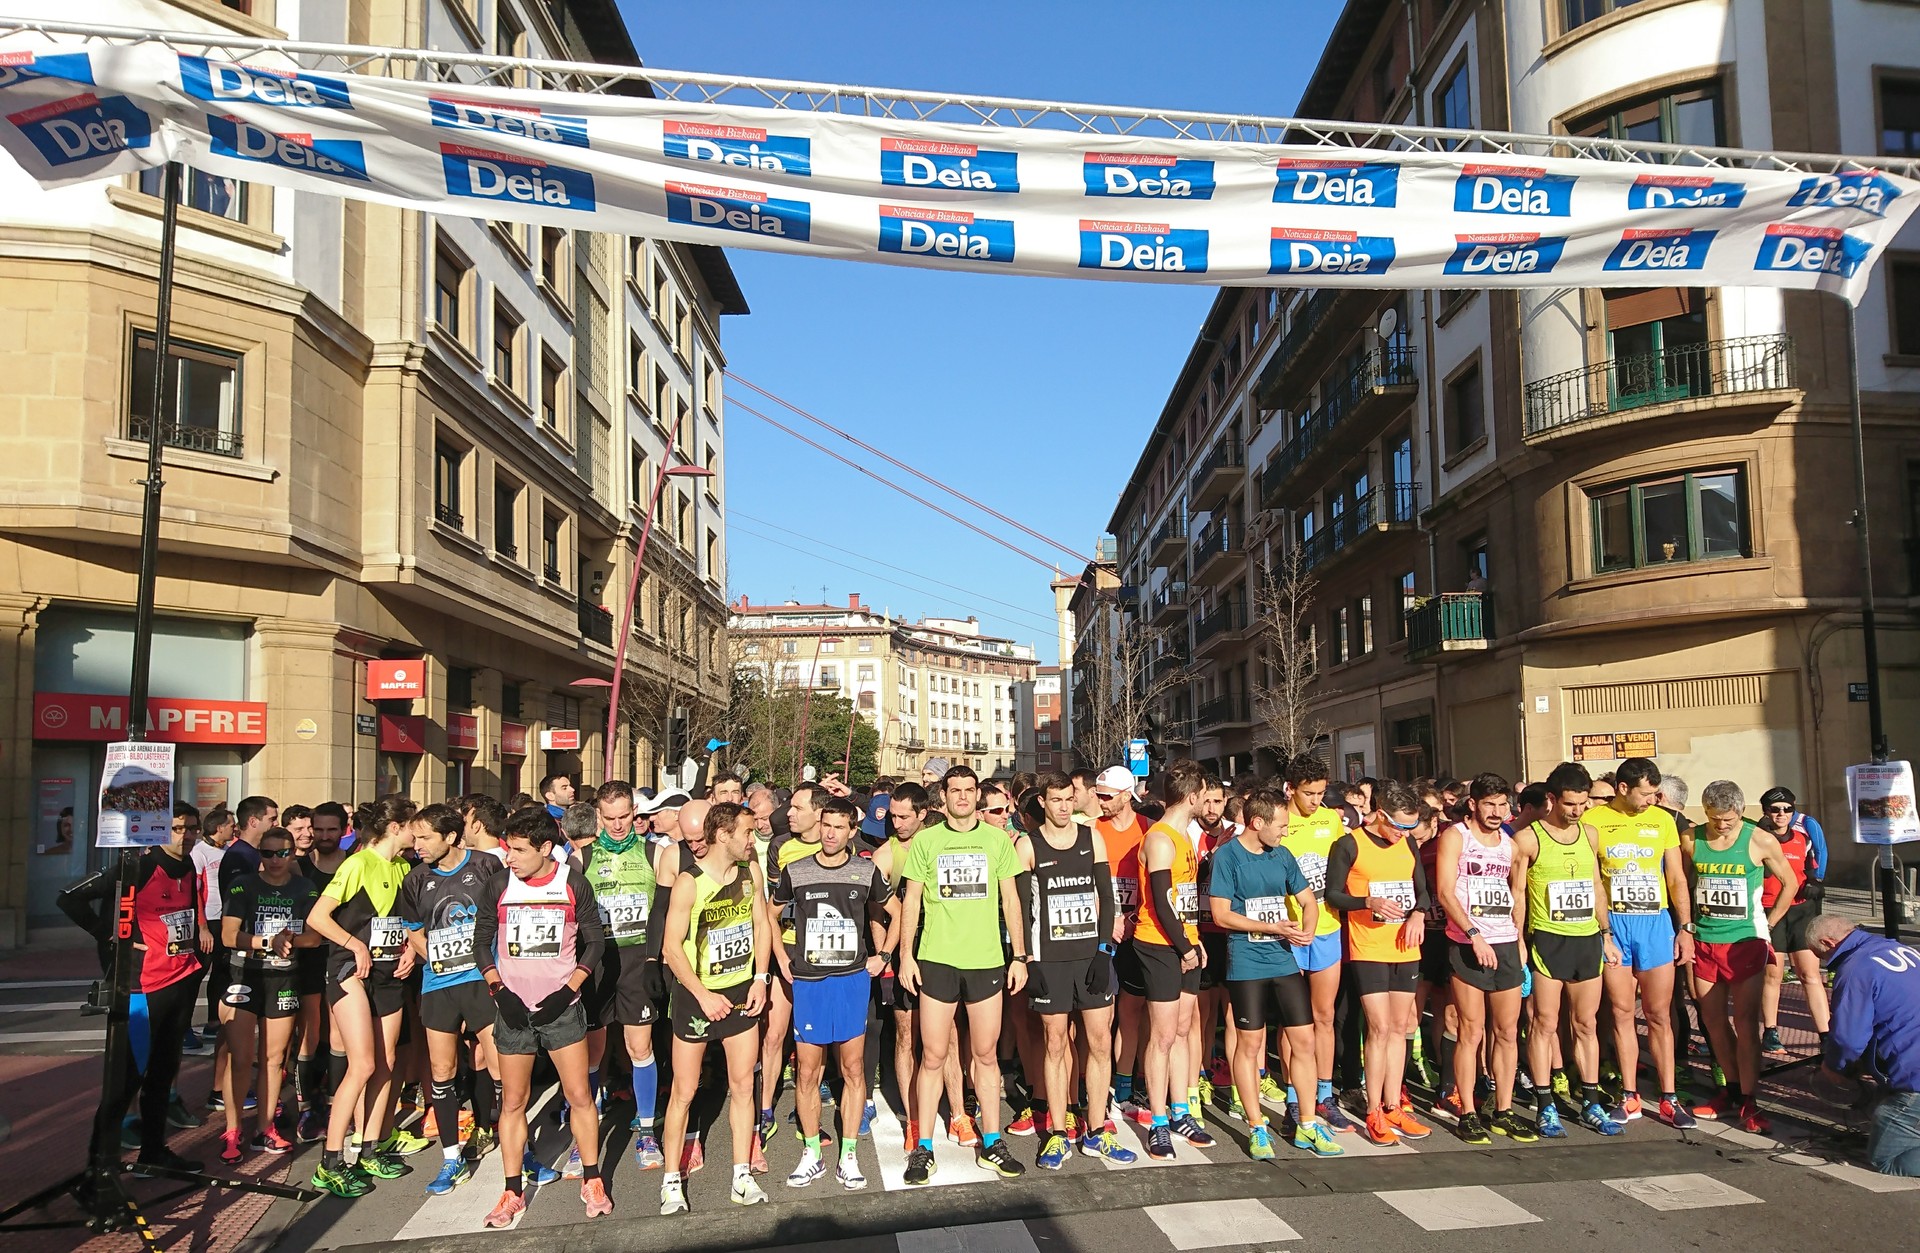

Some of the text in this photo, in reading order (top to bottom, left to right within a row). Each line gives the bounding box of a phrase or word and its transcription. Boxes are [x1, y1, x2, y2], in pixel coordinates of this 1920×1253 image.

[208, 60, 326, 105] Deia
[455, 104, 563, 142] Deia
[677, 123, 761, 141] Noticias de Bizkaia
[236, 123, 344, 173] Deia
[456, 145, 541, 168] Noticias de Bizkaia
[687, 138, 787, 174] Deia
[894, 140, 972, 156] Noticias de Bizkaia
[1097, 153, 1172, 166] Noticias de Bizkaia
[903, 154, 997, 189] Deia
[467, 158, 571, 205] Deia
[1104, 166, 1193, 196] Deia
[1292, 168, 1376, 204] Deia
[679, 183, 762, 201] Noticias de Bizkaia
[1472, 176, 1550, 214] Deia
[1802, 175, 1884, 213] Deia
[690, 196, 786, 235] Deia
[892, 207, 969, 223] Noticias de Bizkaia
[1092, 221, 1165, 233] Noticias de Bizkaia
[1283, 229, 1352, 241] Noticias de Bizkaia
[901, 220, 992, 259] Deia
[1467, 233, 1536, 243] Noticias de Bizkaia
[1100, 234, 1186, 271] Deia
[1288, 242, 1371, 273] Deia
[1462, 243, 1539, 273] Deia
[1620, 237, 1690, 268] Deia
[1573, 735, 1613, 745] SE ALQUILA
[1616, 733, 1654, 742] SE VENDE
[1606, 845, 1654, 859] Kenko
[1047, 876, 1091, 890] Alimco
[257, 895, 294, 905] bathco
[1475, 891, 1510, 906] 1094
[1556, 894, 1589, 909] 1461
[1702, 890, 1739, 906] 1401
[118, 886, 135, 939] GUIL
[258, 905, 292, 914] running
[605, 907, 643, 923] 1237
[1055, 907, 1093, 924] 1112
[175, 924, 191, 940] 578
[382, 930, 404, 946] 789
[709, 930, 725, 945] XXIII
[433, 938, 473, 960] 1323
[715, 937, 750, 960] 1523
[277, 1001, 300, 1010] TEAM
